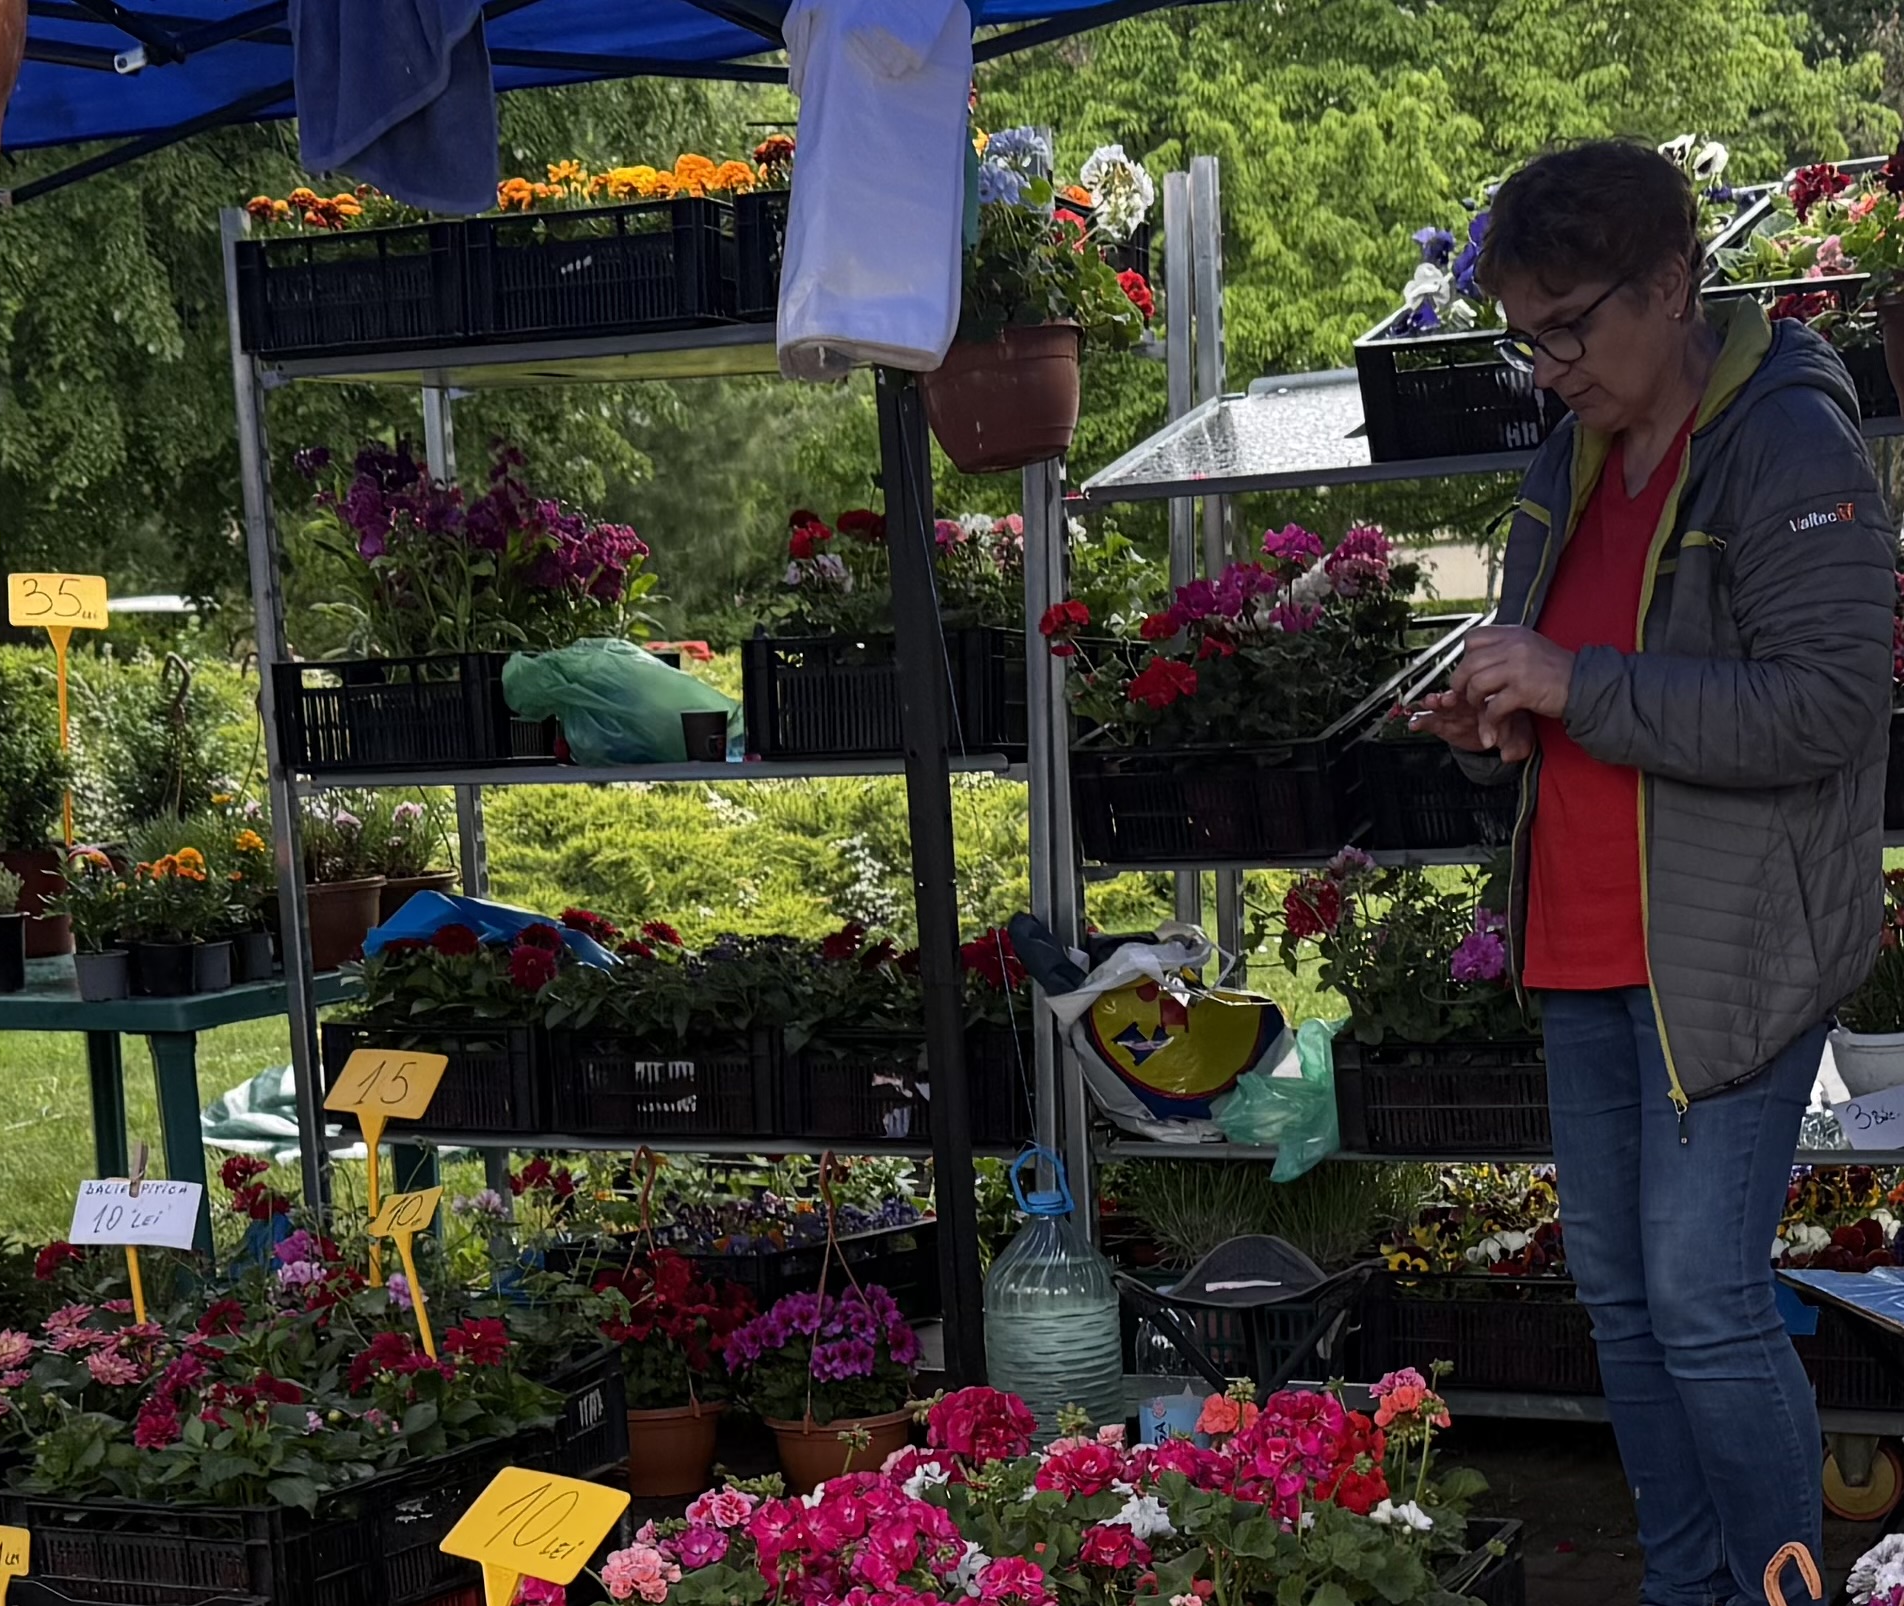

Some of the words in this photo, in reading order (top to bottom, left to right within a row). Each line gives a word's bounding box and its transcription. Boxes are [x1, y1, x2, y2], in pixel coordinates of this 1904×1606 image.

[22, 578, 83, 617] 35
[353, 1060, 417, 1105] 15
[1846, 1103, 1872, 1130] 3
[93, 1204, 123, 1233] 10
[385, 1194, 424, 1232] 10
[484, 1482, 580, 1548] 10
